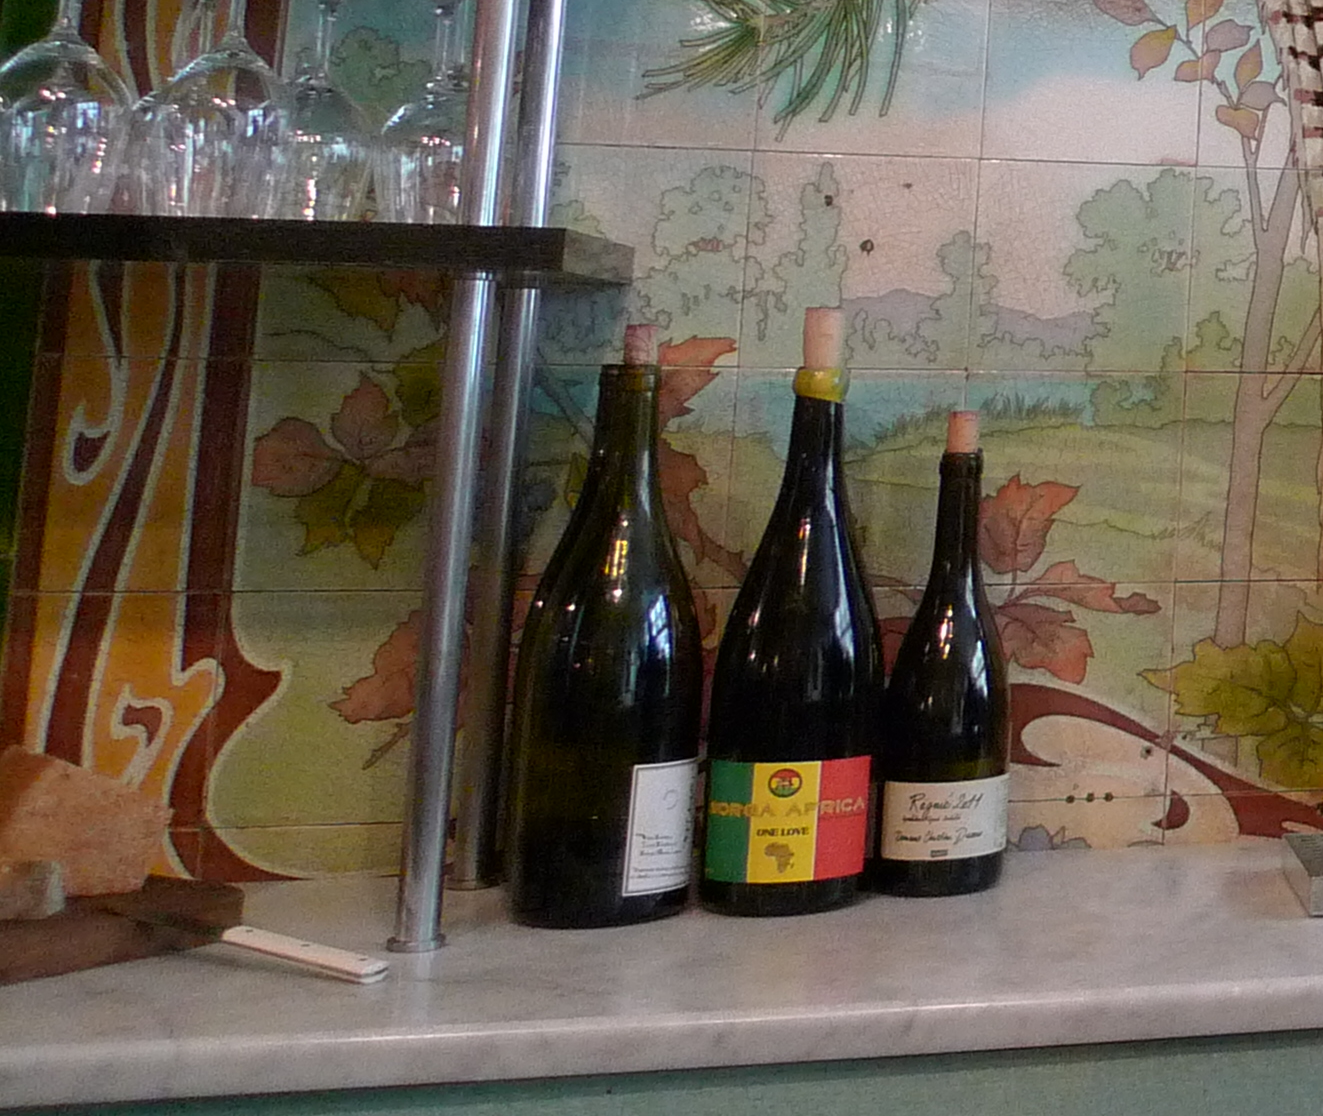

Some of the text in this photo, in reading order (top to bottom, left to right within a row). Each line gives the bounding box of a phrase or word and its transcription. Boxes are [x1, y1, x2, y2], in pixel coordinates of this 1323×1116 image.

[785, 796, 865, 817] AFRICA
[756, 827, 810, 838] ONE LOVE
